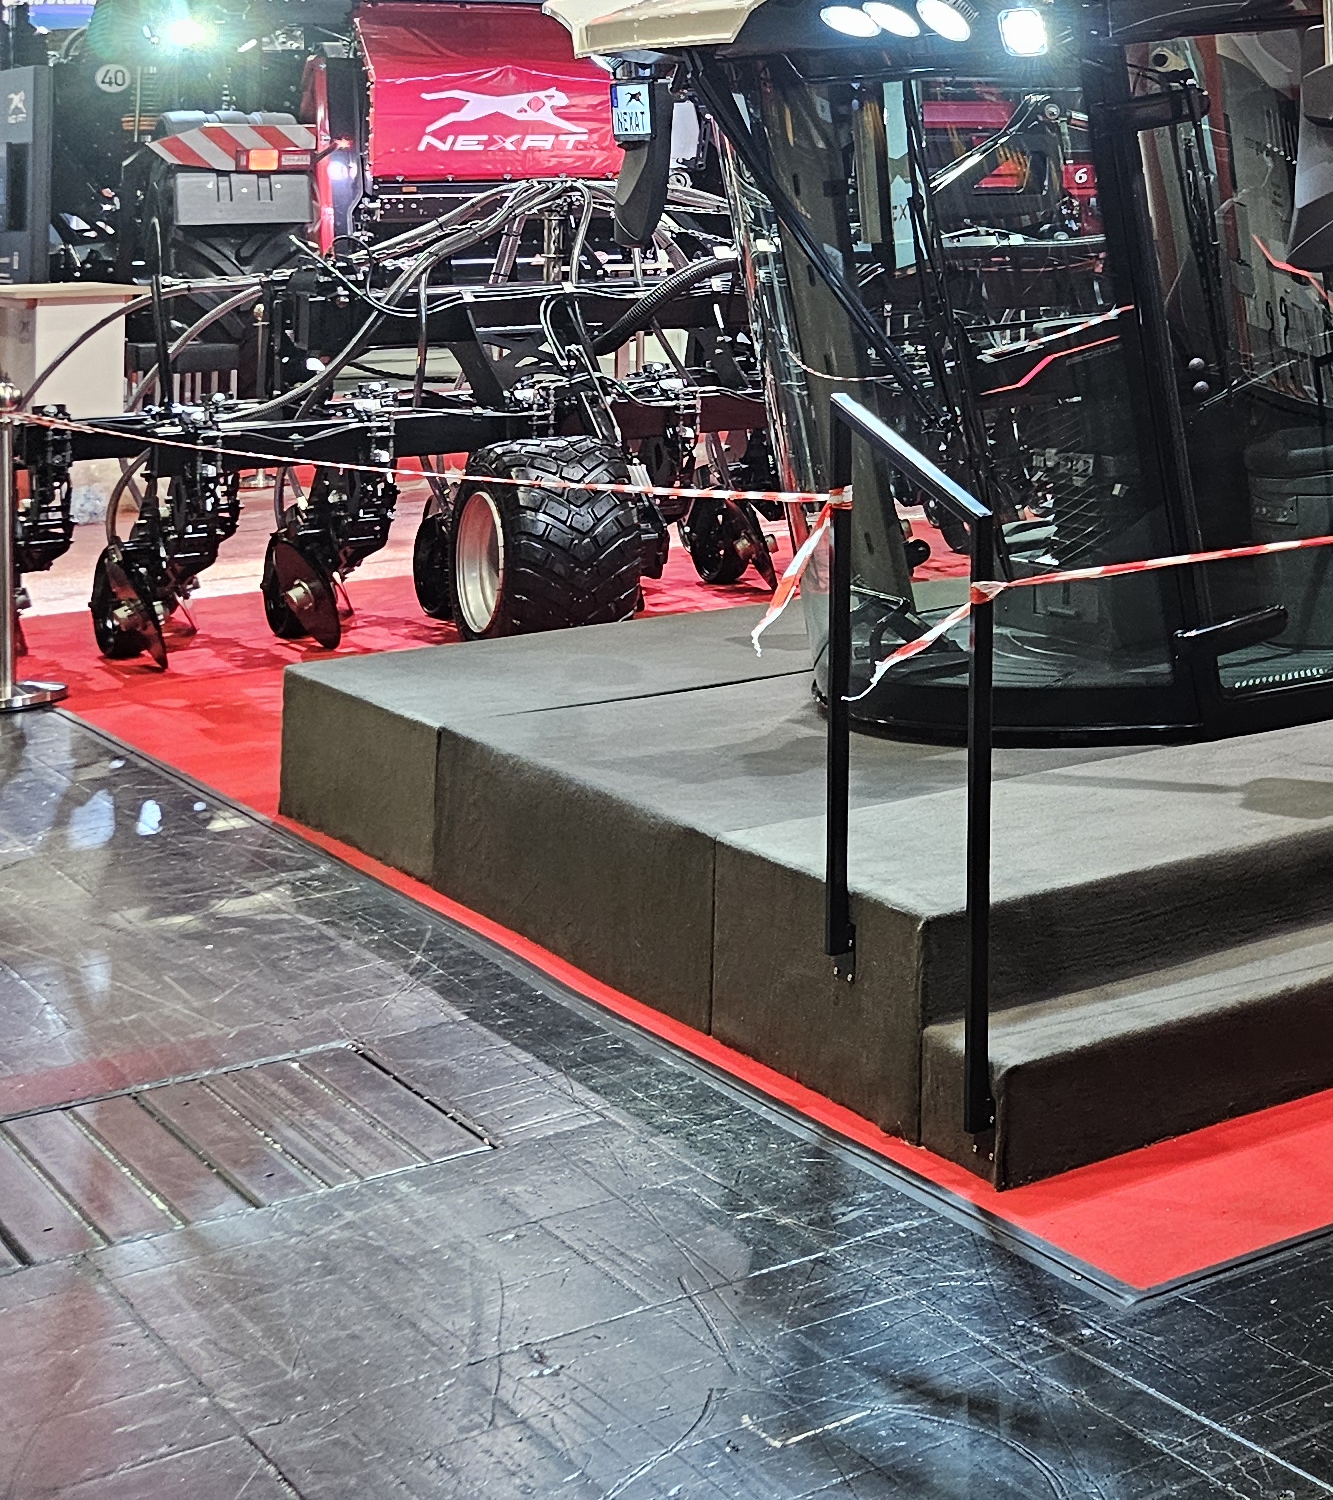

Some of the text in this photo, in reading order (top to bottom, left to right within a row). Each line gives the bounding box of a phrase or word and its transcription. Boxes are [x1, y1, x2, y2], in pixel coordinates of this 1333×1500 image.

[101, 69, 126, 87] 40
[615, 110, 647, 133] NEXAT
[417, 134, 589, 152] NEXAT
[1074, 167, 1088, 184] 6
